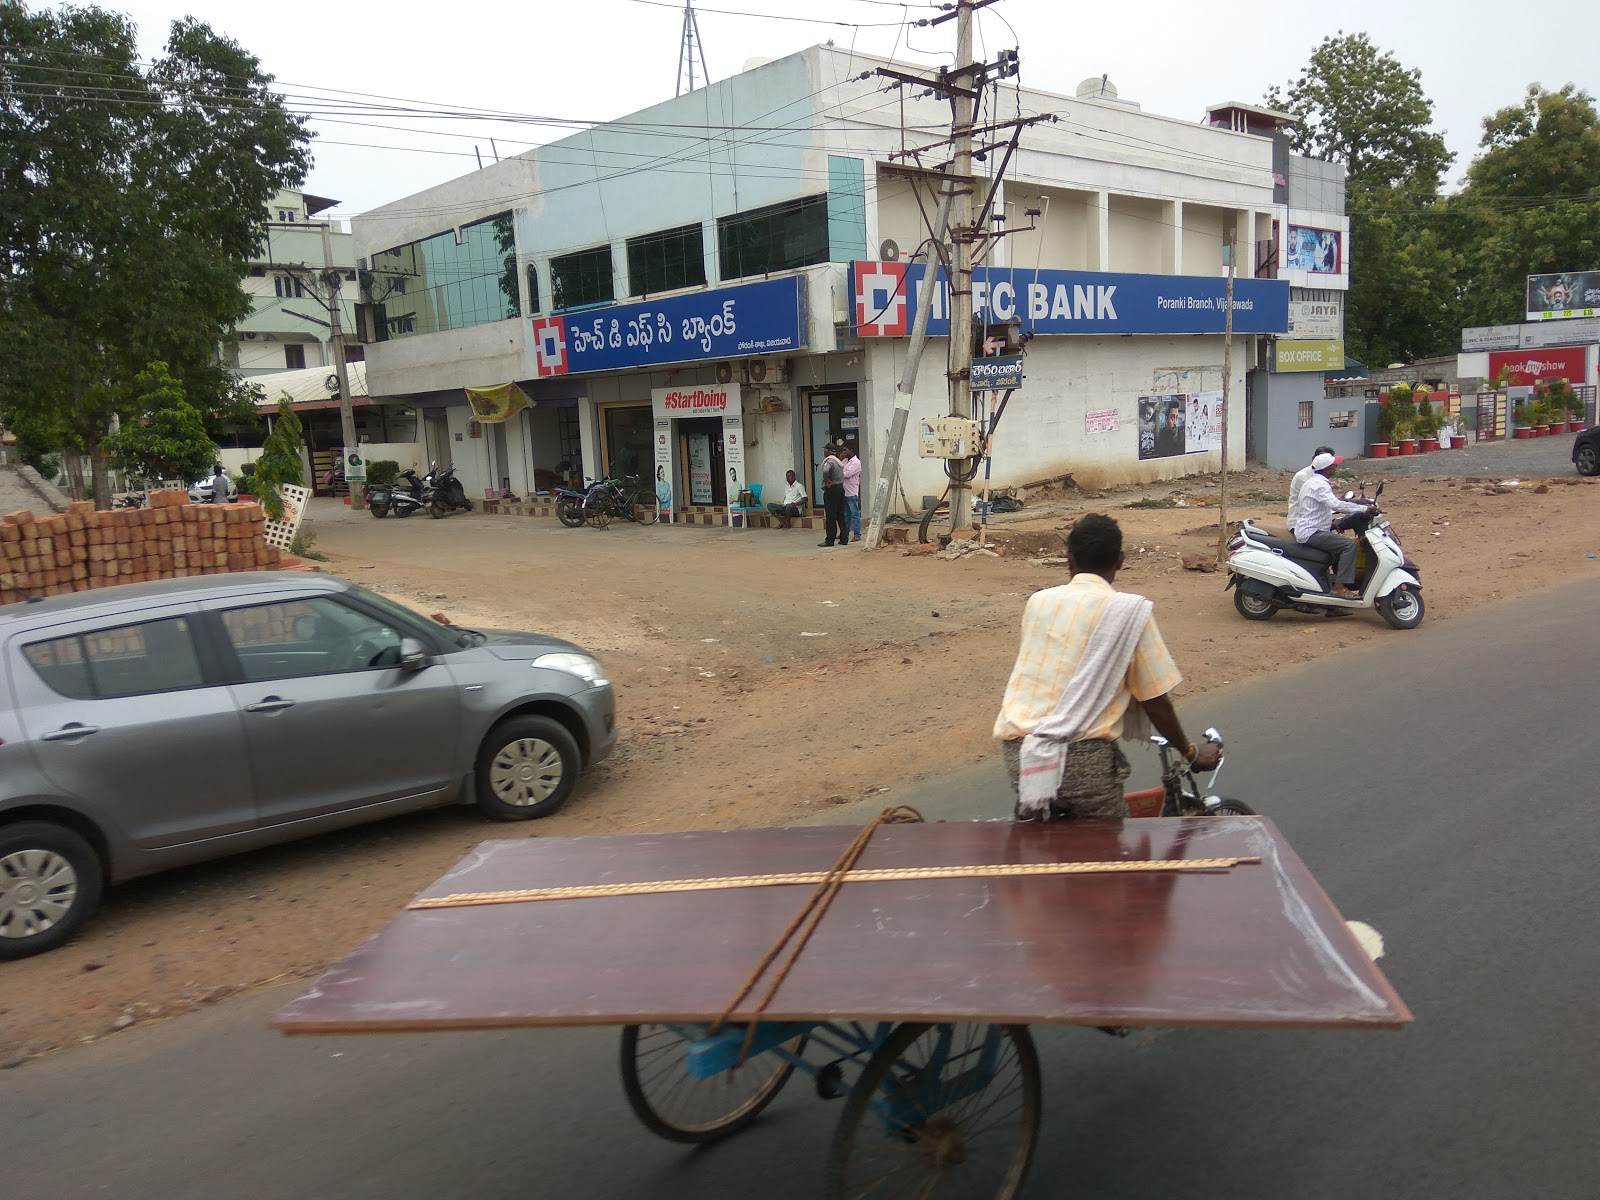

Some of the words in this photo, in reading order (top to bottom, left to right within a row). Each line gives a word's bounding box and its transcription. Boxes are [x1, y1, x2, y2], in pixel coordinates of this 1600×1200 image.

[916, 279, 1015, 320] HFC
[1028, 283, 1118, 320] BANK
[1157, 296, 1186, 309] Poranki
[1187, 296, 1215, 311] Branch,
[1216, 297, 1253, 312] Vijaawada
[1311, 305, 1337, 315] JAYA
[609, 319, 622, 348] డి
[657, 313, 672, 343] సి
[1279, 351, 1295, 362] BOX
[1296, 350, 1322, 362] OFFICE
[665, 389, 727, 411] #StartDoing
